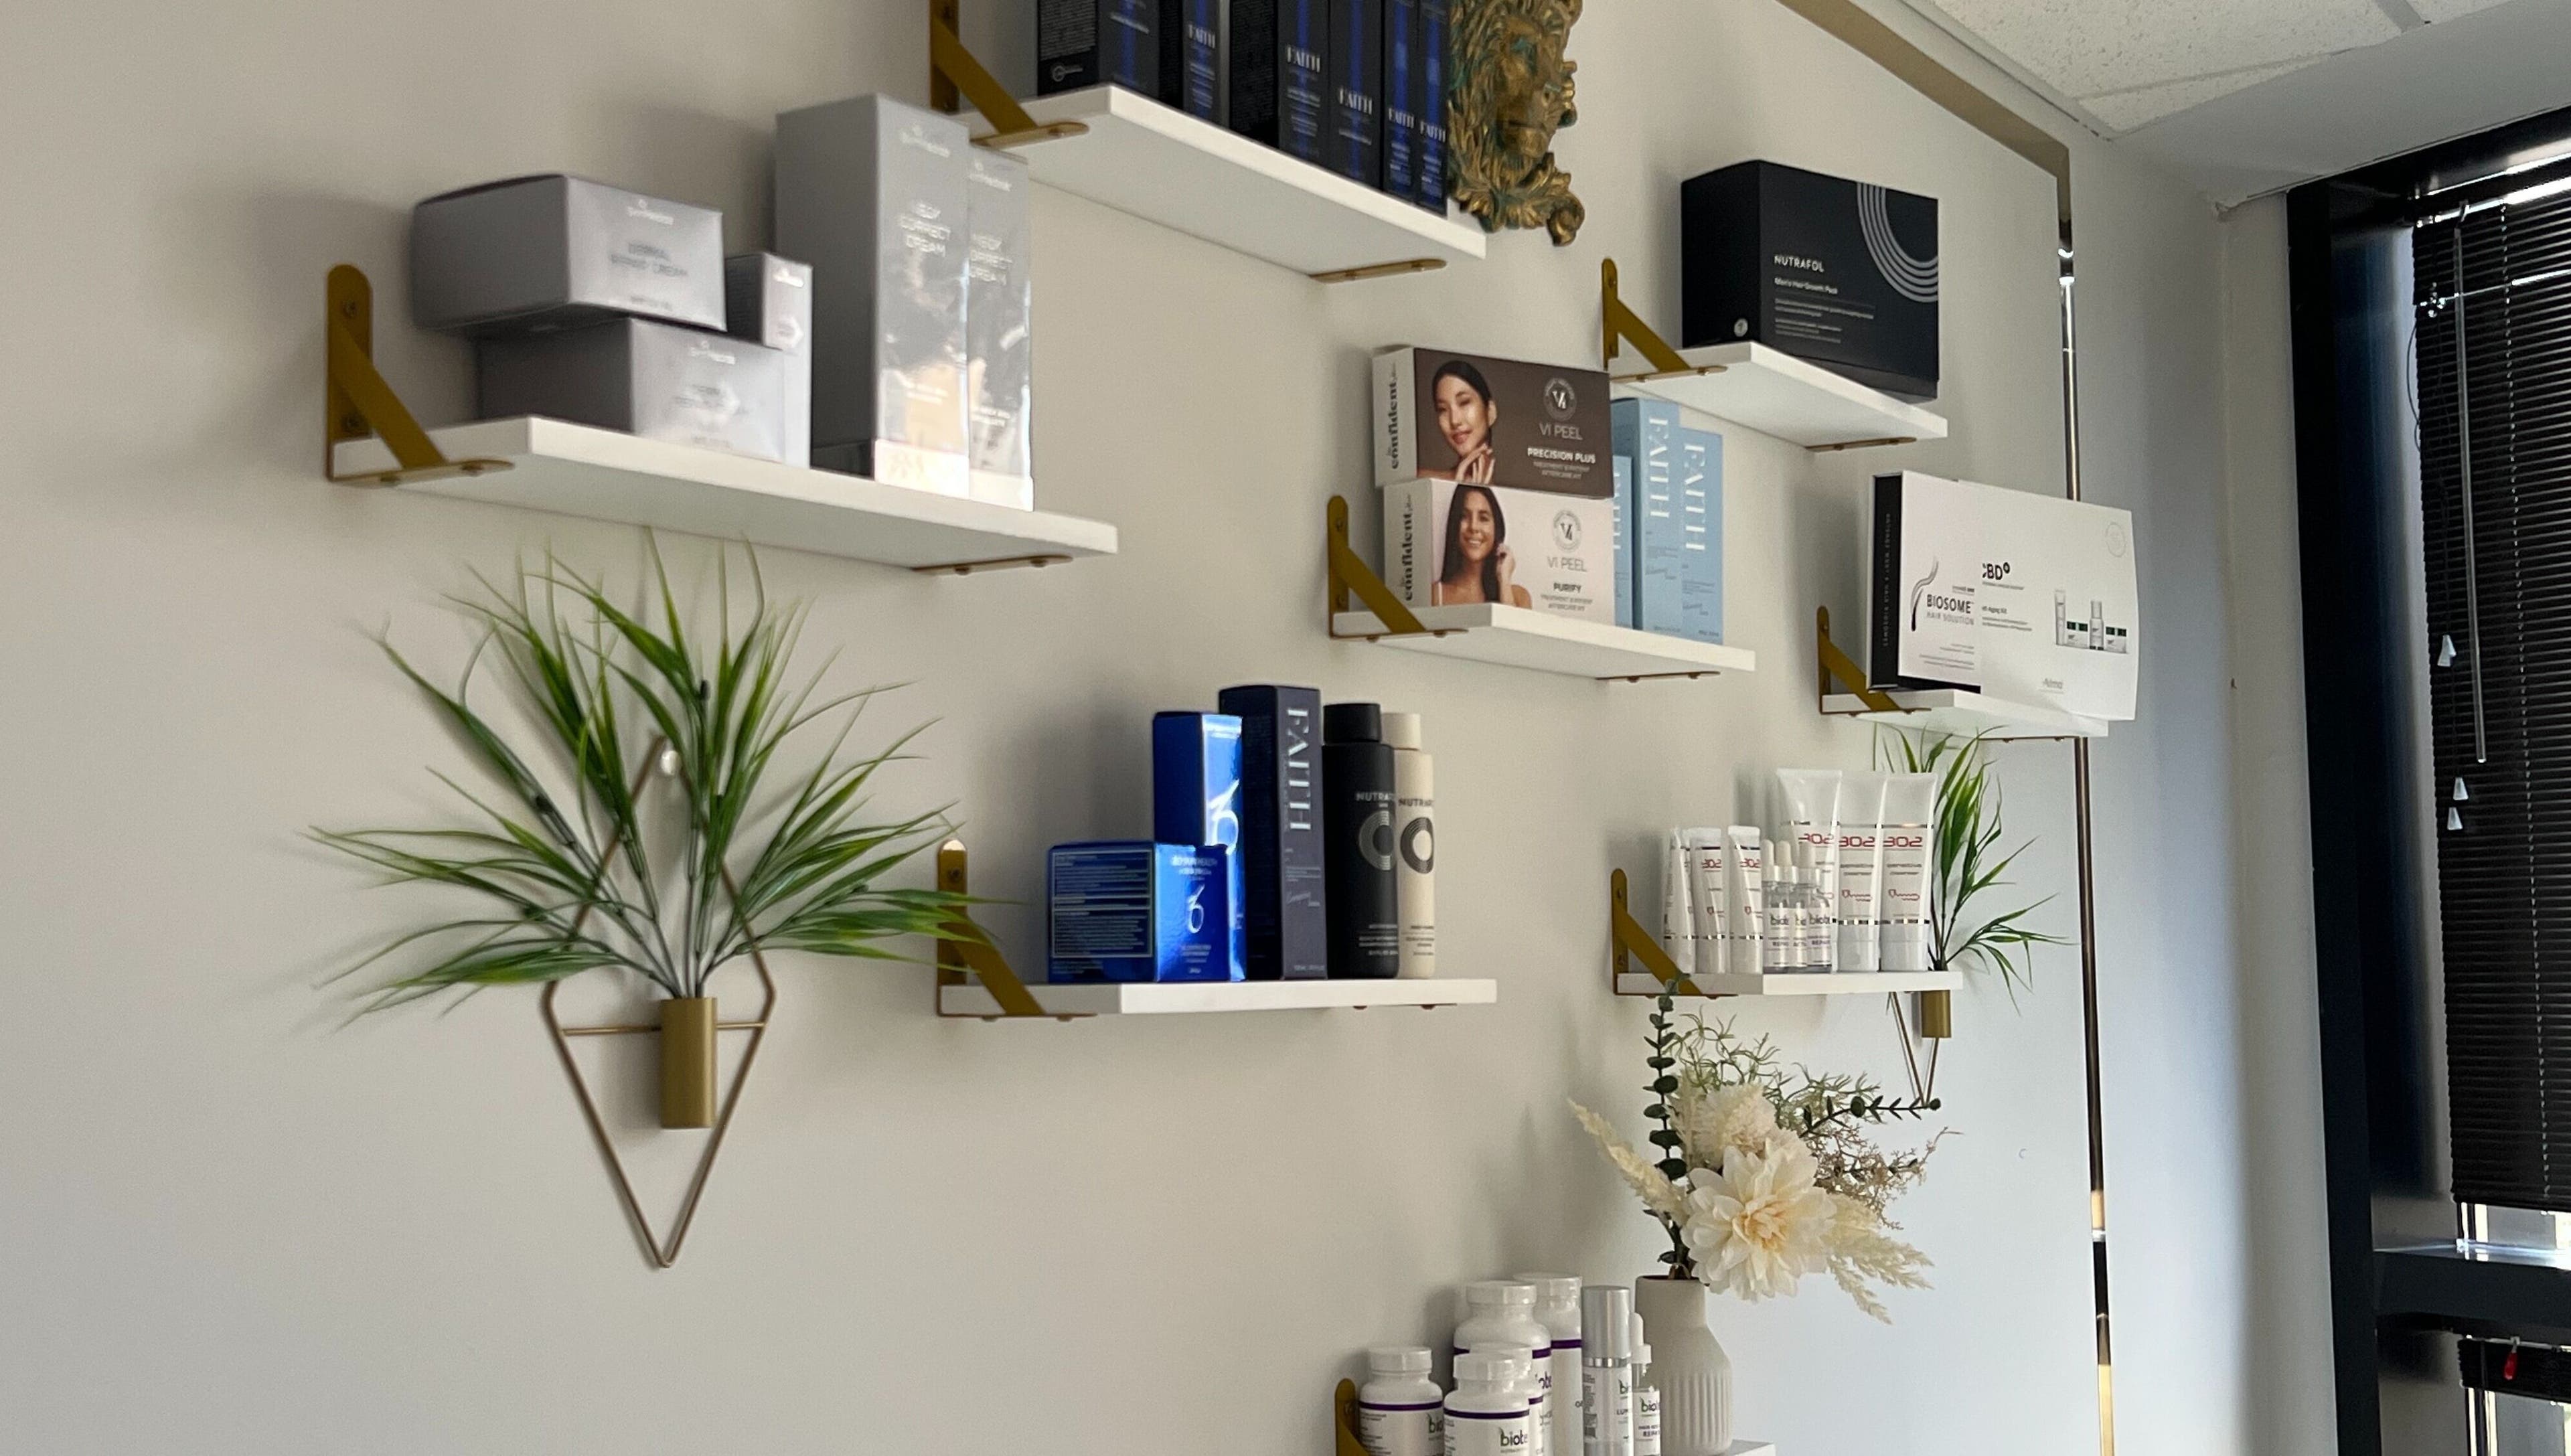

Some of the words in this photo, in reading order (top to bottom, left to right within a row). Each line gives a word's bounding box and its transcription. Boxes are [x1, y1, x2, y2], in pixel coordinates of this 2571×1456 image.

[1286, 46, 1321, 73] FAITH
[1339, 87, 1373, 114] FAITH
[1388, 108, 1415, 129] FAITH
[1420, 120, 1447, 143] FAITH
[1774, 254, 1824, 272] NUTRAFOL
[1387, 382, 1399, 471] confident
[1539, 422, 1552, 436] VI
[1554, 424, 1583, 440] PEEL
[1527, 447, 1574, 462] PRECISION
[1575, 453, 1596, 464] PLUS
[1648, 417, 1670, 518] FAITH
[1684, 444, 1705, 551] FAITH
[1401, 513, 1414, 602] confident
[1547, 556, 1558, 568] VI
[1561, 557, 1587, 572] PEEL
[1927, 594, 1971, 614] BIOSOME
[1287, 708, 1312, 831] FAITH
[1839, 836, 1875, 847] 302
[1883, 836, 1922, 847] 302
[1701, 858, 1723, 869] 302
[1499, 1427, 1527, 1447] biote
